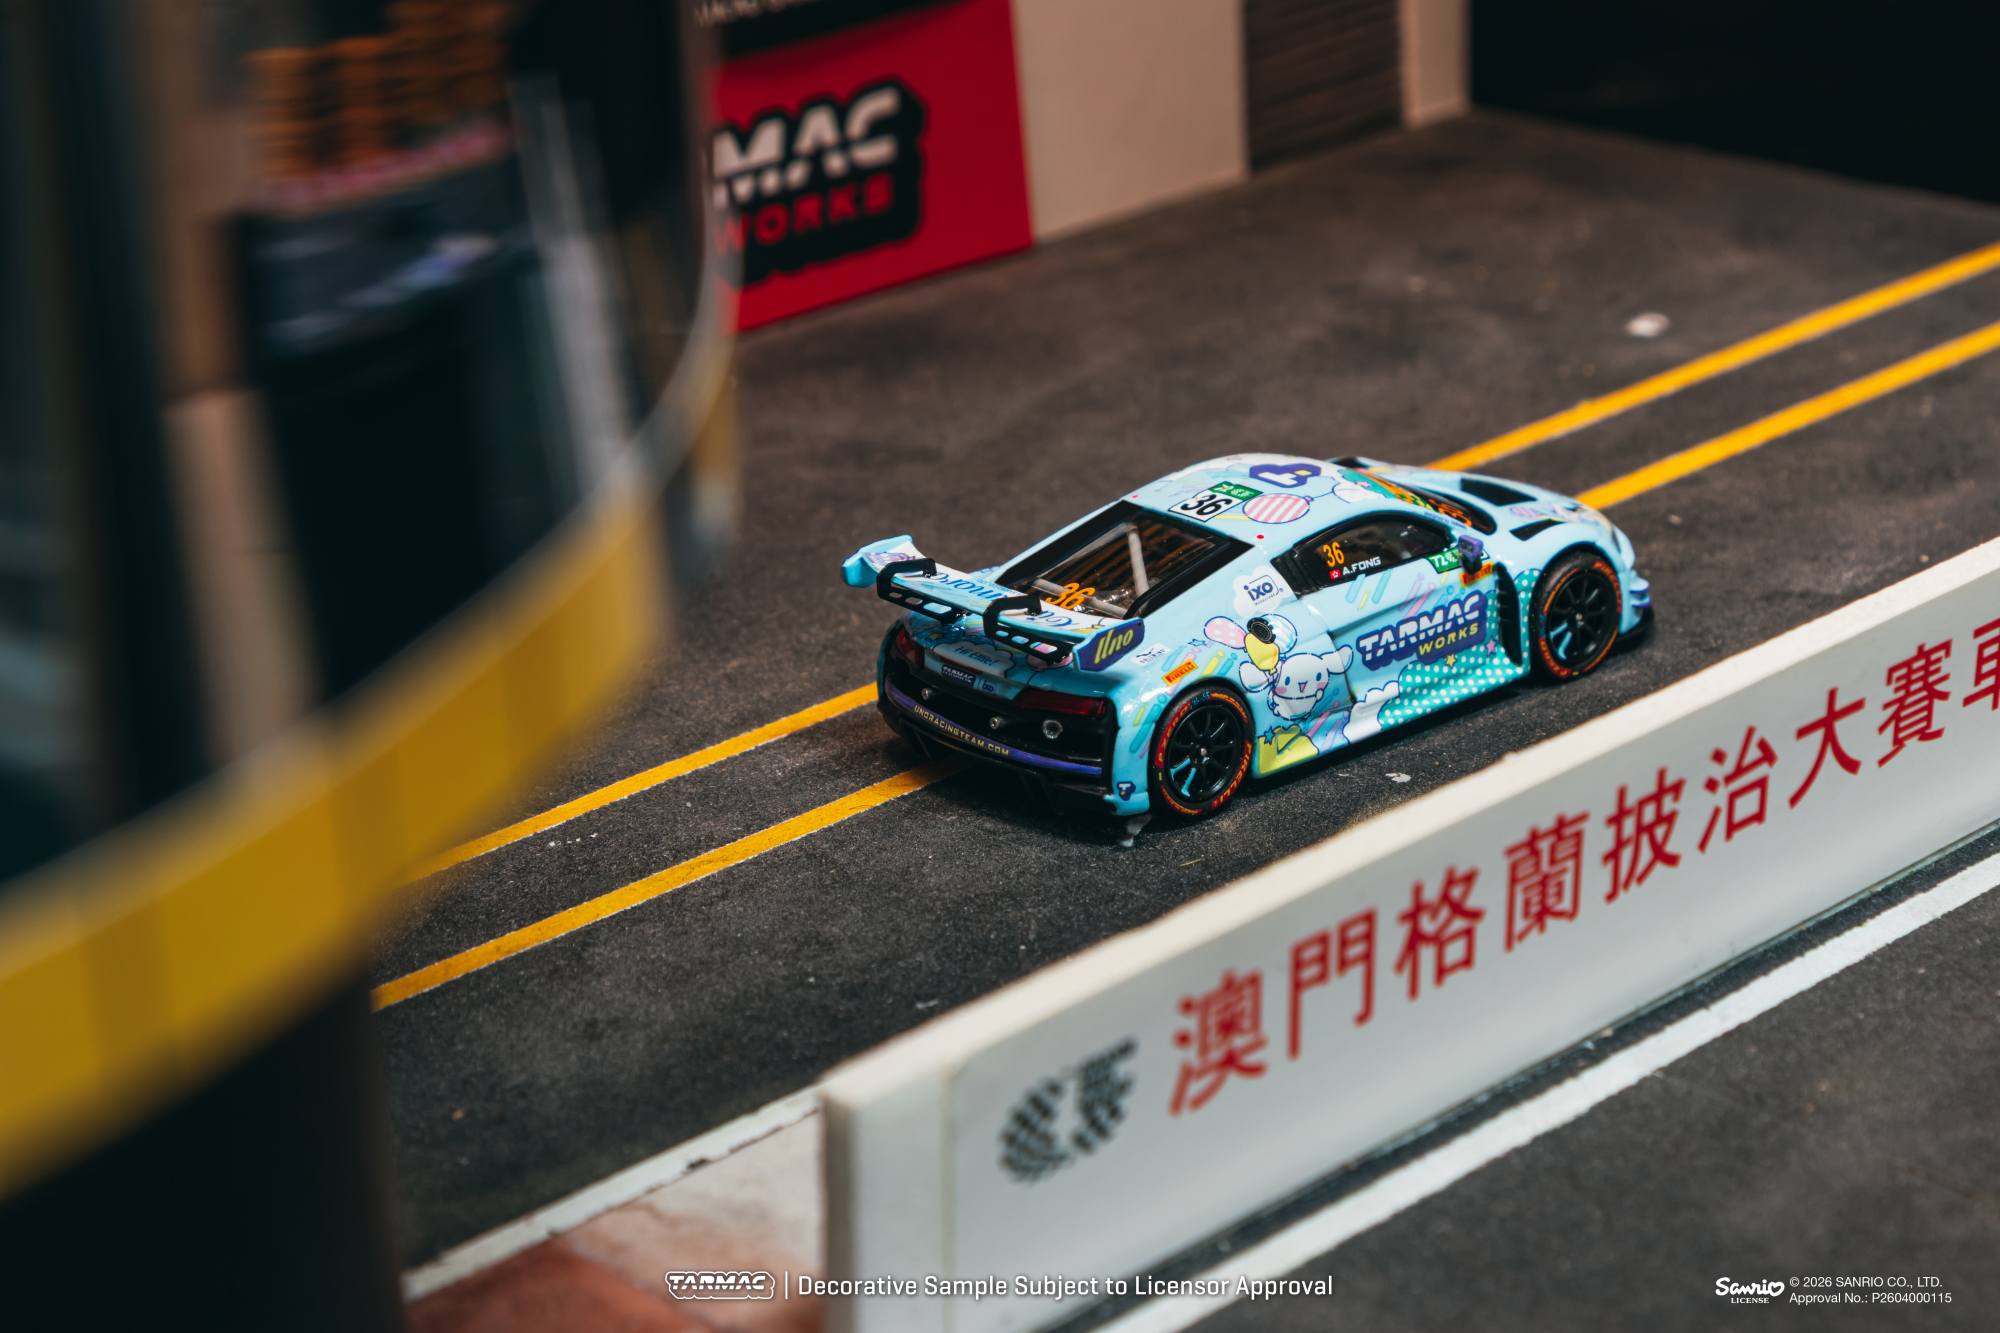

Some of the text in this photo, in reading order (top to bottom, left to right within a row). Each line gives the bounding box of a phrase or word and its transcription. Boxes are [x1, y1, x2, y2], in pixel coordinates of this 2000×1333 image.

[711, 86, 899, 210] MAC
[714, 172, 893, 257] WORKS
[1180, 493, 1233, 516] 36
[1323, 541, 1345, 568] 36
[1342, 556, 1381, 576] A.FONG
[1046, 582, 1096, 610] 36
[1359, 593, 1480, 662] TARMAC
[1418, 622, 1480, 657] WORKS
[913, 704, 1010, 756] UNORACINGTEAM.COM
